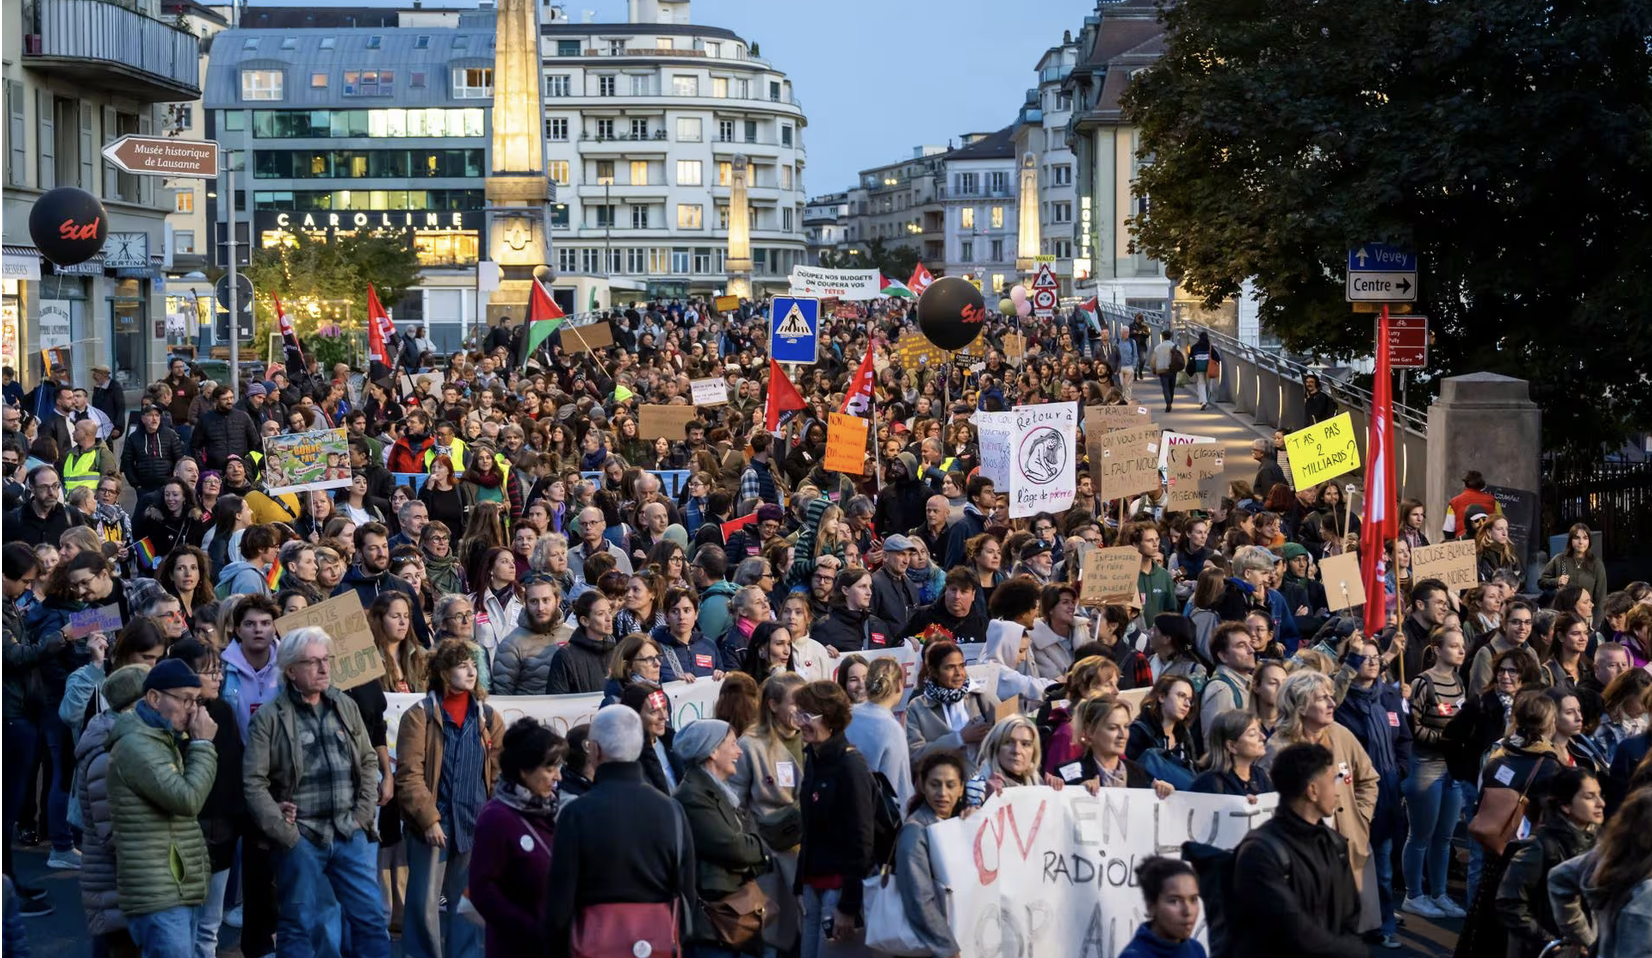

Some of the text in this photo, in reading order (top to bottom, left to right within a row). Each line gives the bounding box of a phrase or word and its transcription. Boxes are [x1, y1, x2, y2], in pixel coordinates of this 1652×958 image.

[134, 144, 210, 159] Musée historique
[145, 157, 200, 169] de Lausanne
[277, 212, 463, 227] CAROLINE
[59, 216, 100, 241] Sud
[1374, 249, 1408, 266] Vevey
[797, 270, 824, 280] COUPEZ
[1353, 277, 1391, 292] Centre
[1016, 408, 1073, 431] Retour à
[1324, 422, 1341, 440] PAS
[1317, 443, 1325, 457] 2
[1040, 488, 1048, 500] de
[1414, 546, 1445, 566] BLOUSE
[1446, 568, 1471, 583] NOIRE
[1069, 791, 1130, 846] EN
[1154, 802, 1279, 857] LUT
